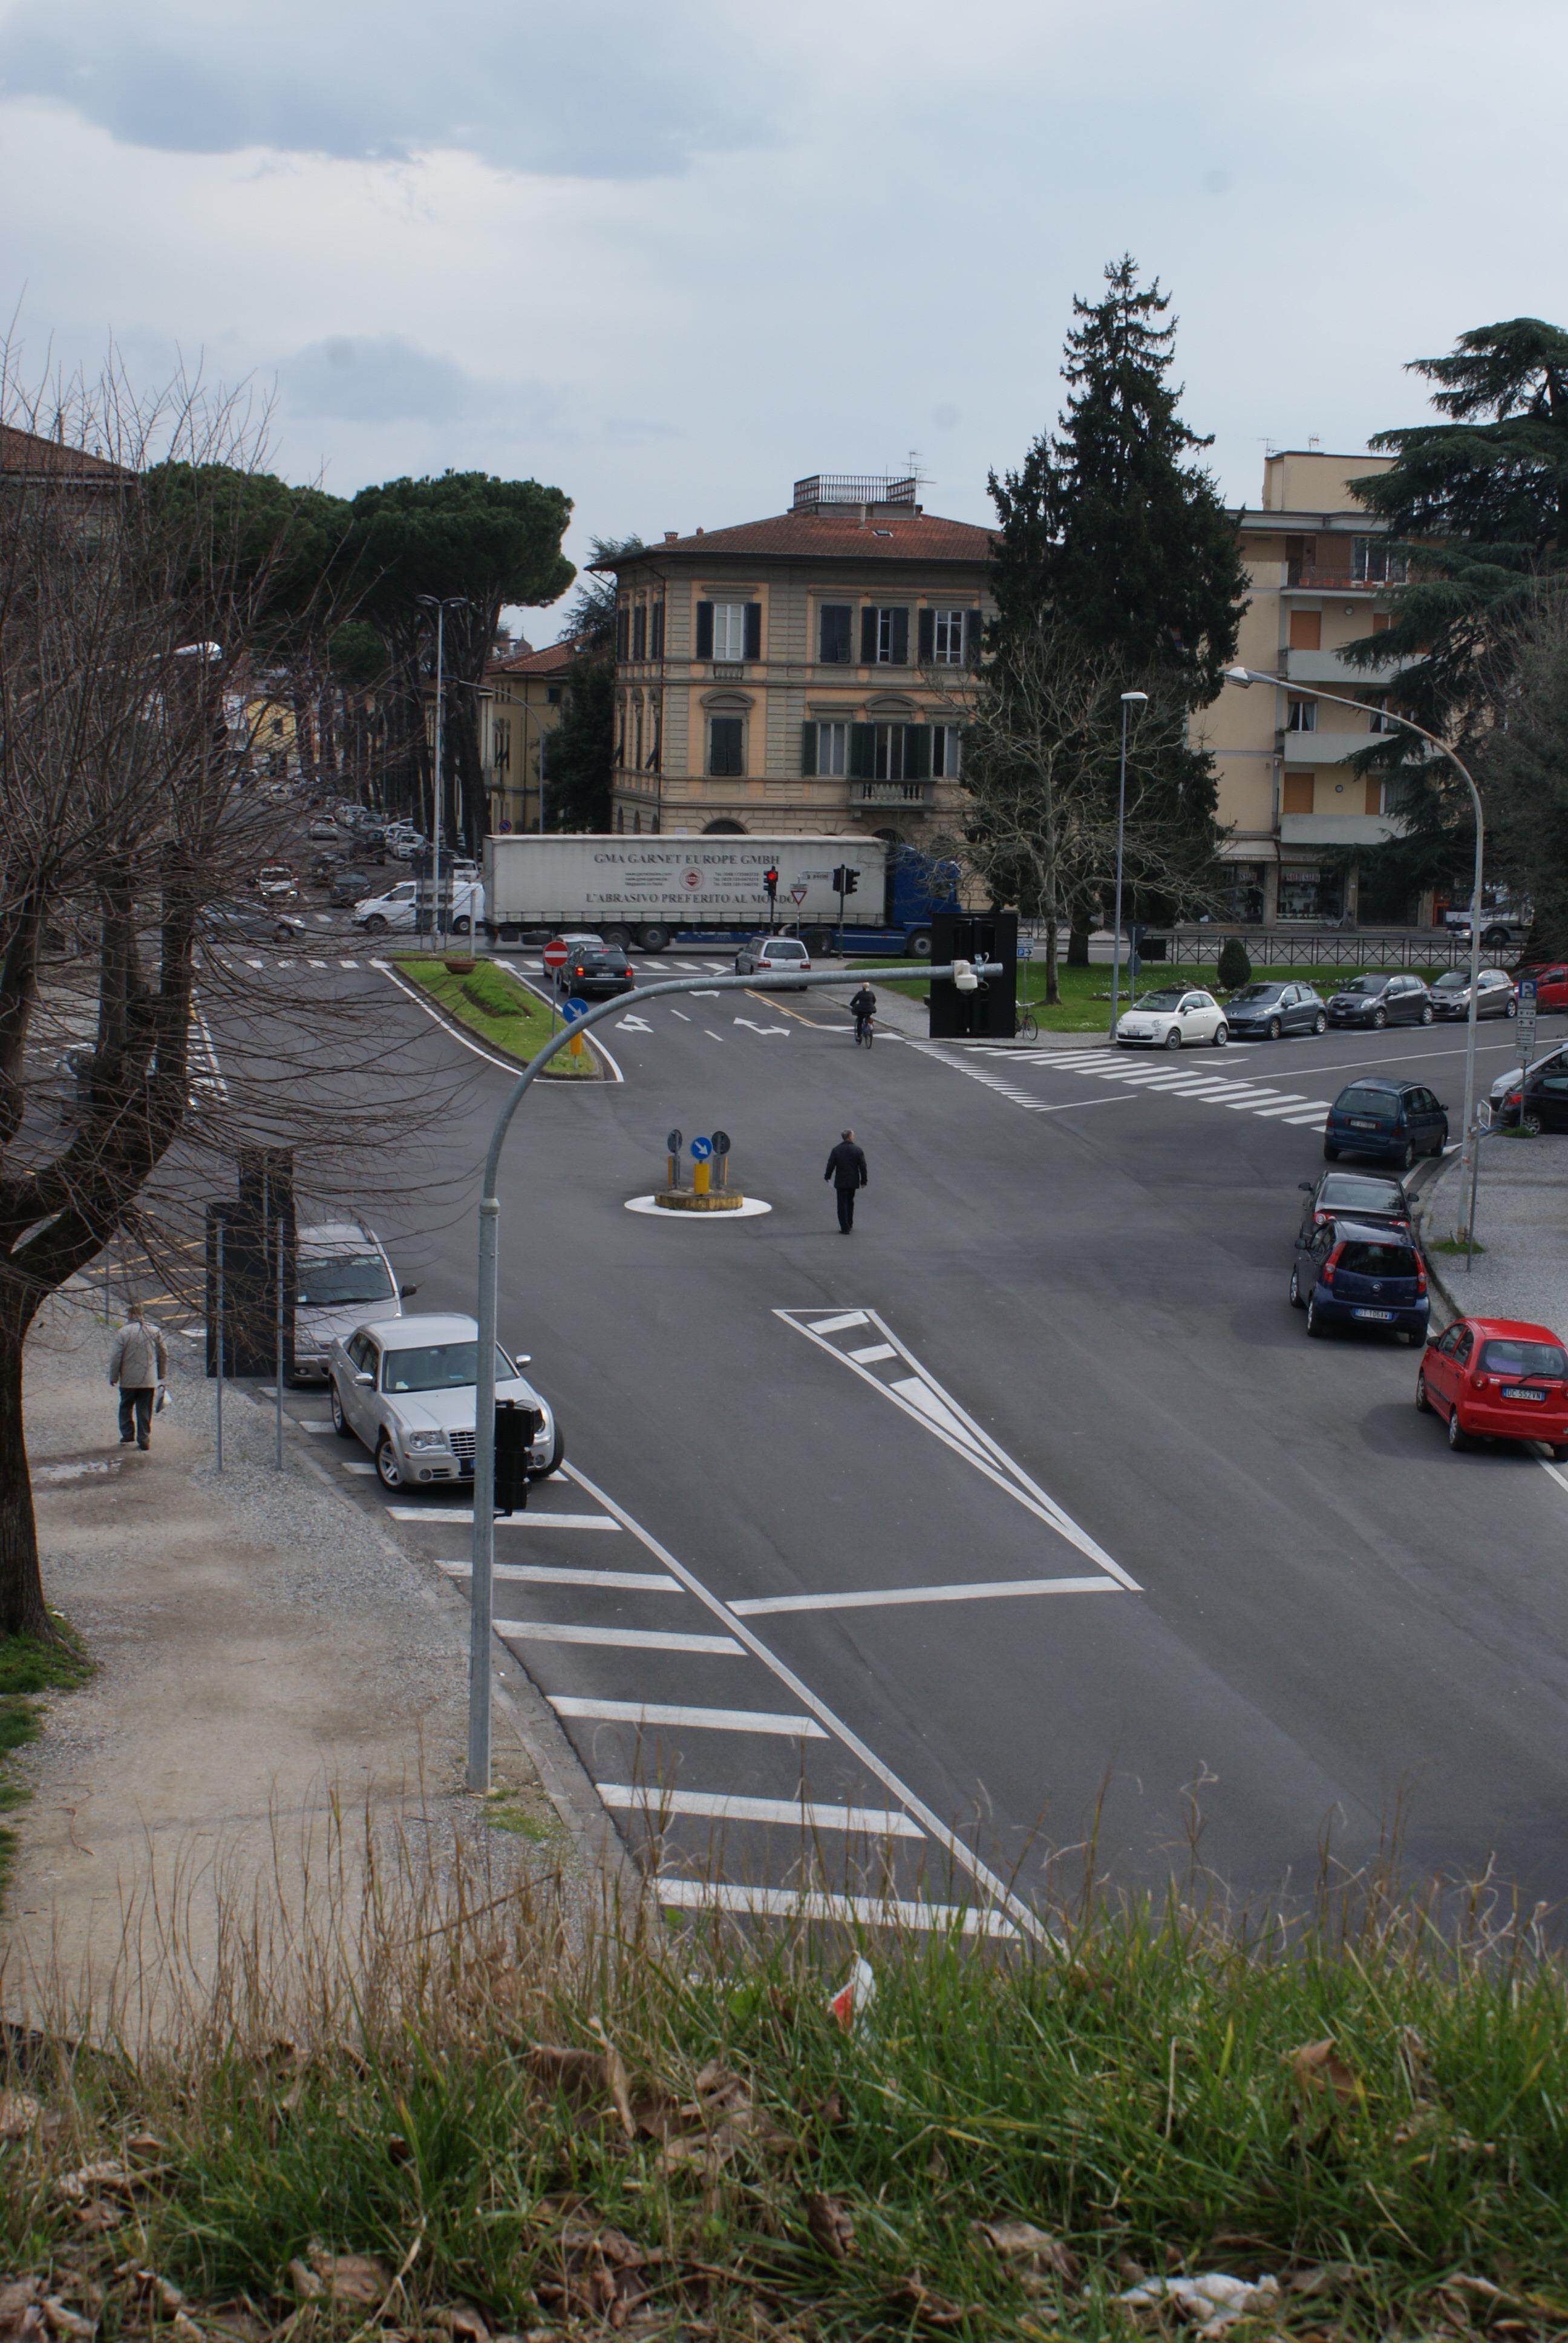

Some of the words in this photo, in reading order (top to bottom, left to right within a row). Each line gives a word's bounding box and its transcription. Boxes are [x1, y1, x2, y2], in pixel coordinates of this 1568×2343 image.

[593, 854, 625, 863] GMA
[627, 854, 682, 864] GARNET
[685, 854, 738, 864] EUROPE
[740, 855, 780, 865] GMBH
[586, 893, 659, 903] L'ABRASIVO
[662, 894, 730, 903] PREFERITO
[731, 894, 748, 903] AL
[1521, 981, 1534, 998] P
